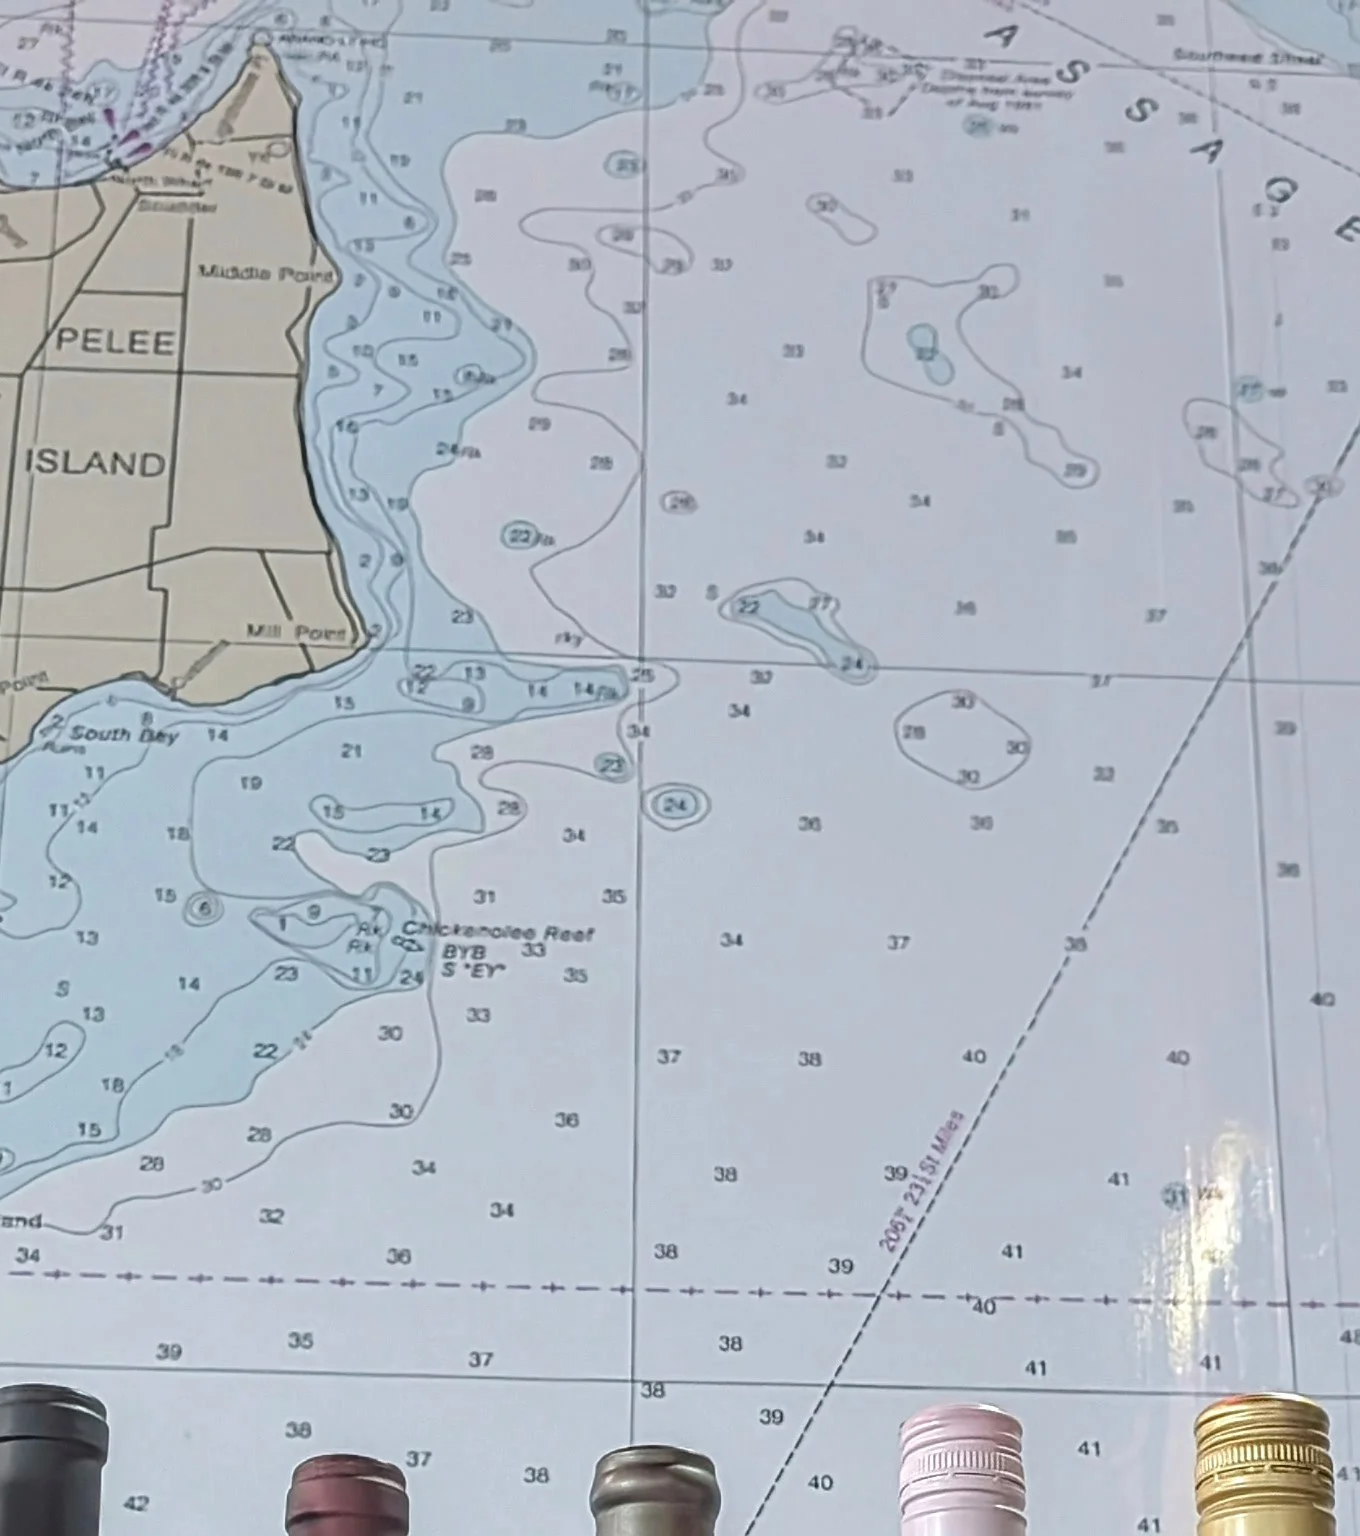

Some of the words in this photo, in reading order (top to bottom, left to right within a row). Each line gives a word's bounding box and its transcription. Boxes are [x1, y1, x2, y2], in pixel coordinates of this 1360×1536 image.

[280, 264, 334, 283] Point
[56, 328, 175, 356] PELEE
[25, 448, 166, 480] ISLAND
[296, 625, 347, 642] Point
[69, 726, 131, 743] South
[543, 924, 597, 943] Reef
[442, 944, 487, 961] BYB
[15, 1247, 41, 1264] 34
